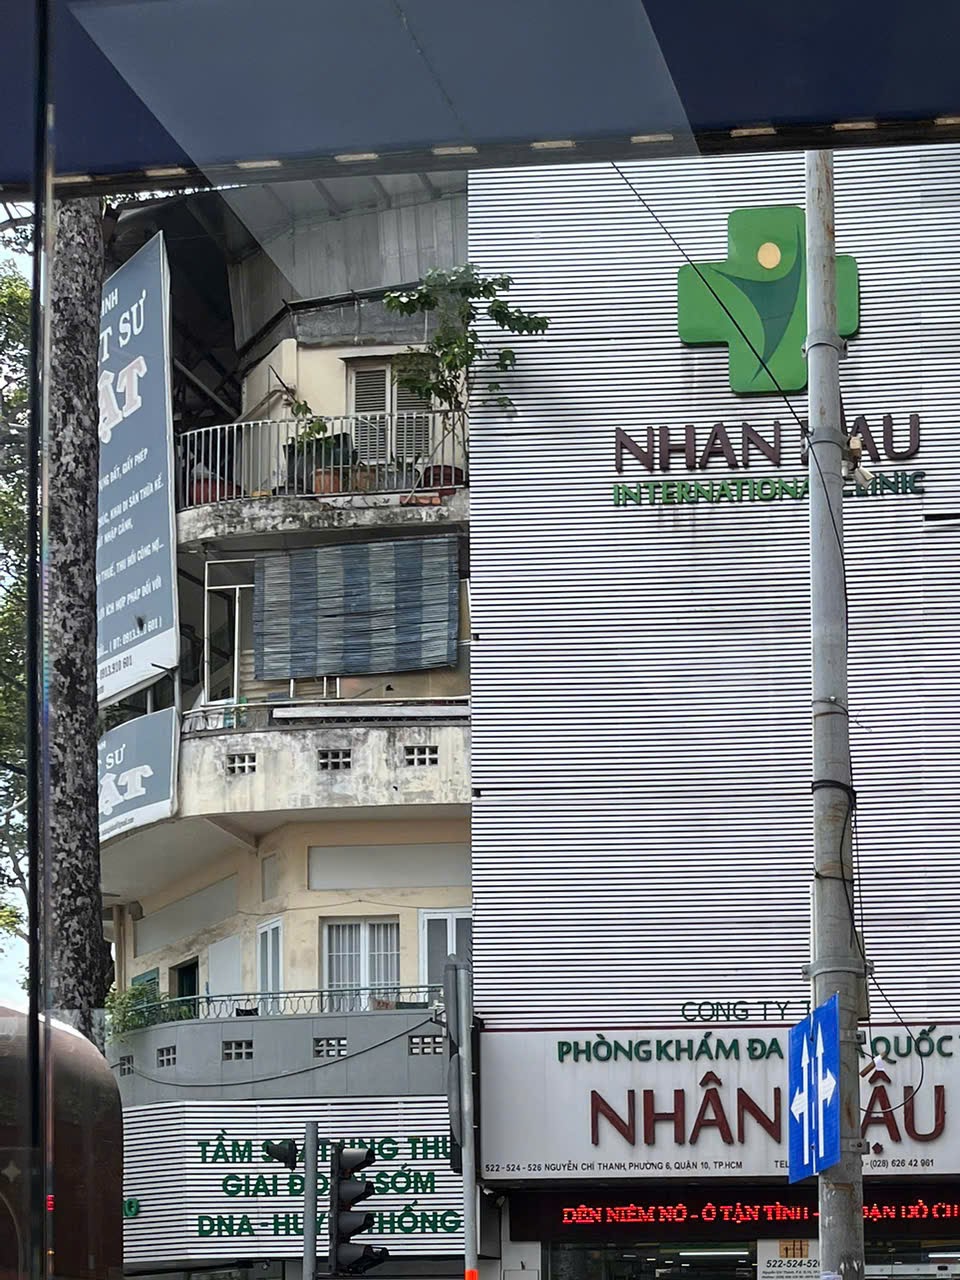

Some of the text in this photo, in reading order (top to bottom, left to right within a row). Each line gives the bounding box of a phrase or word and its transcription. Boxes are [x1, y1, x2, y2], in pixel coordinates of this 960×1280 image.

[615, 413, 920, 473] NHAN AU
[613, 470, 812, 506] INTERNATIONA
[757, 1001, 790, 1021] TY
[557, 1033, 652, 1063] PHÒNG
[655, 1031, 740, 1062] KHÁM
[746, 1037, 784, 1060] ĐA
[870, 1025, 953, 1064] QUỐC
[590, 1070, 947, 1154] NHÂN ẬU
[544, 1160, 578, 1172] NGUYỄN
[580, 1160, 595, 1171] CHÍ
[222, 1174, 278, 1196] GIAI
[198, 1215, 256, 1236] DNA
[766, 1259, 820, 1269] 522-524-52
